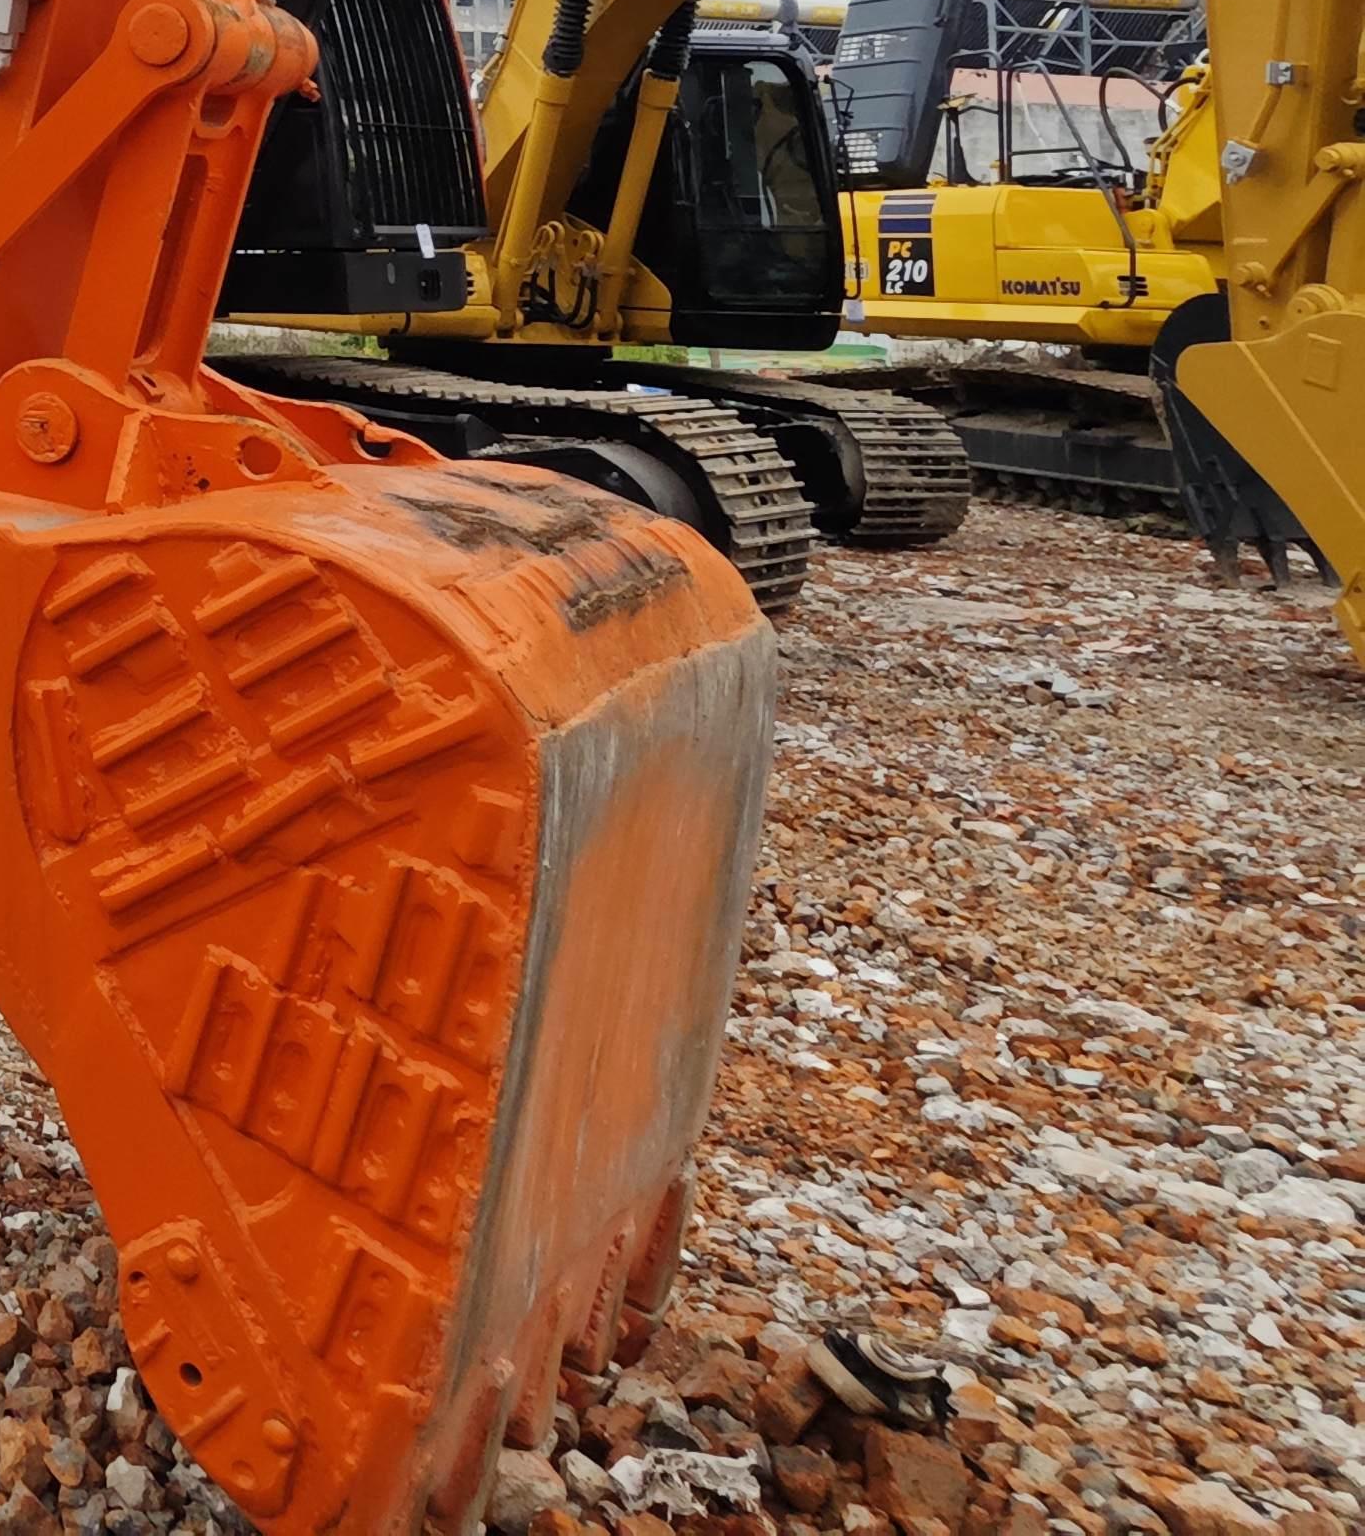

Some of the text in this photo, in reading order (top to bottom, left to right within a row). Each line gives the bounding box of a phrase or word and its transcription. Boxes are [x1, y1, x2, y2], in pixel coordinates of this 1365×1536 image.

[888, 241, 912, 258] PC
[886, 259, 928, 283] 210
[885, 281, 903, 294] LC
[1001, 277, 1080, 296] KOMATSU
